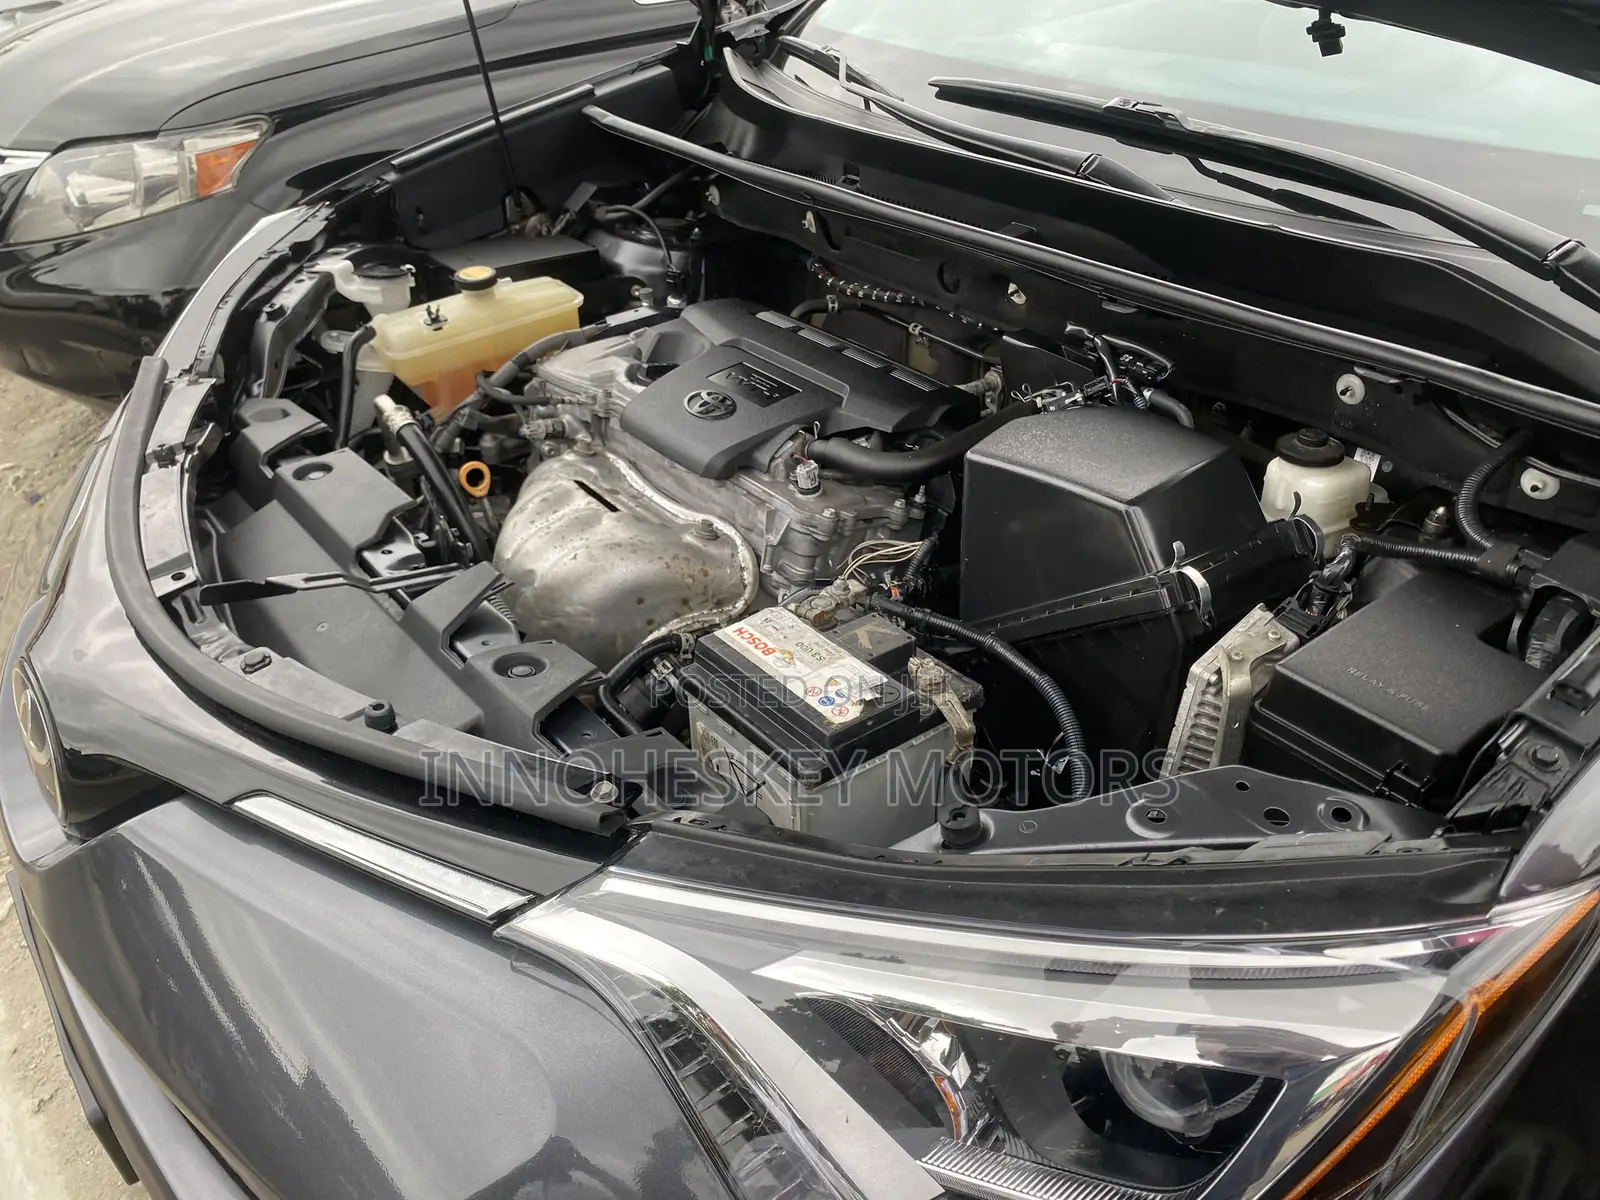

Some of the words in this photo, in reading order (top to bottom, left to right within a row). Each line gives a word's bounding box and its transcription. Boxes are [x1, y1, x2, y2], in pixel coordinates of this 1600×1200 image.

[732, 627, 776, 656] BOSCH
[1346, 666, 1385, 688] RELAY
[1386, 687, 1396, 695] &
